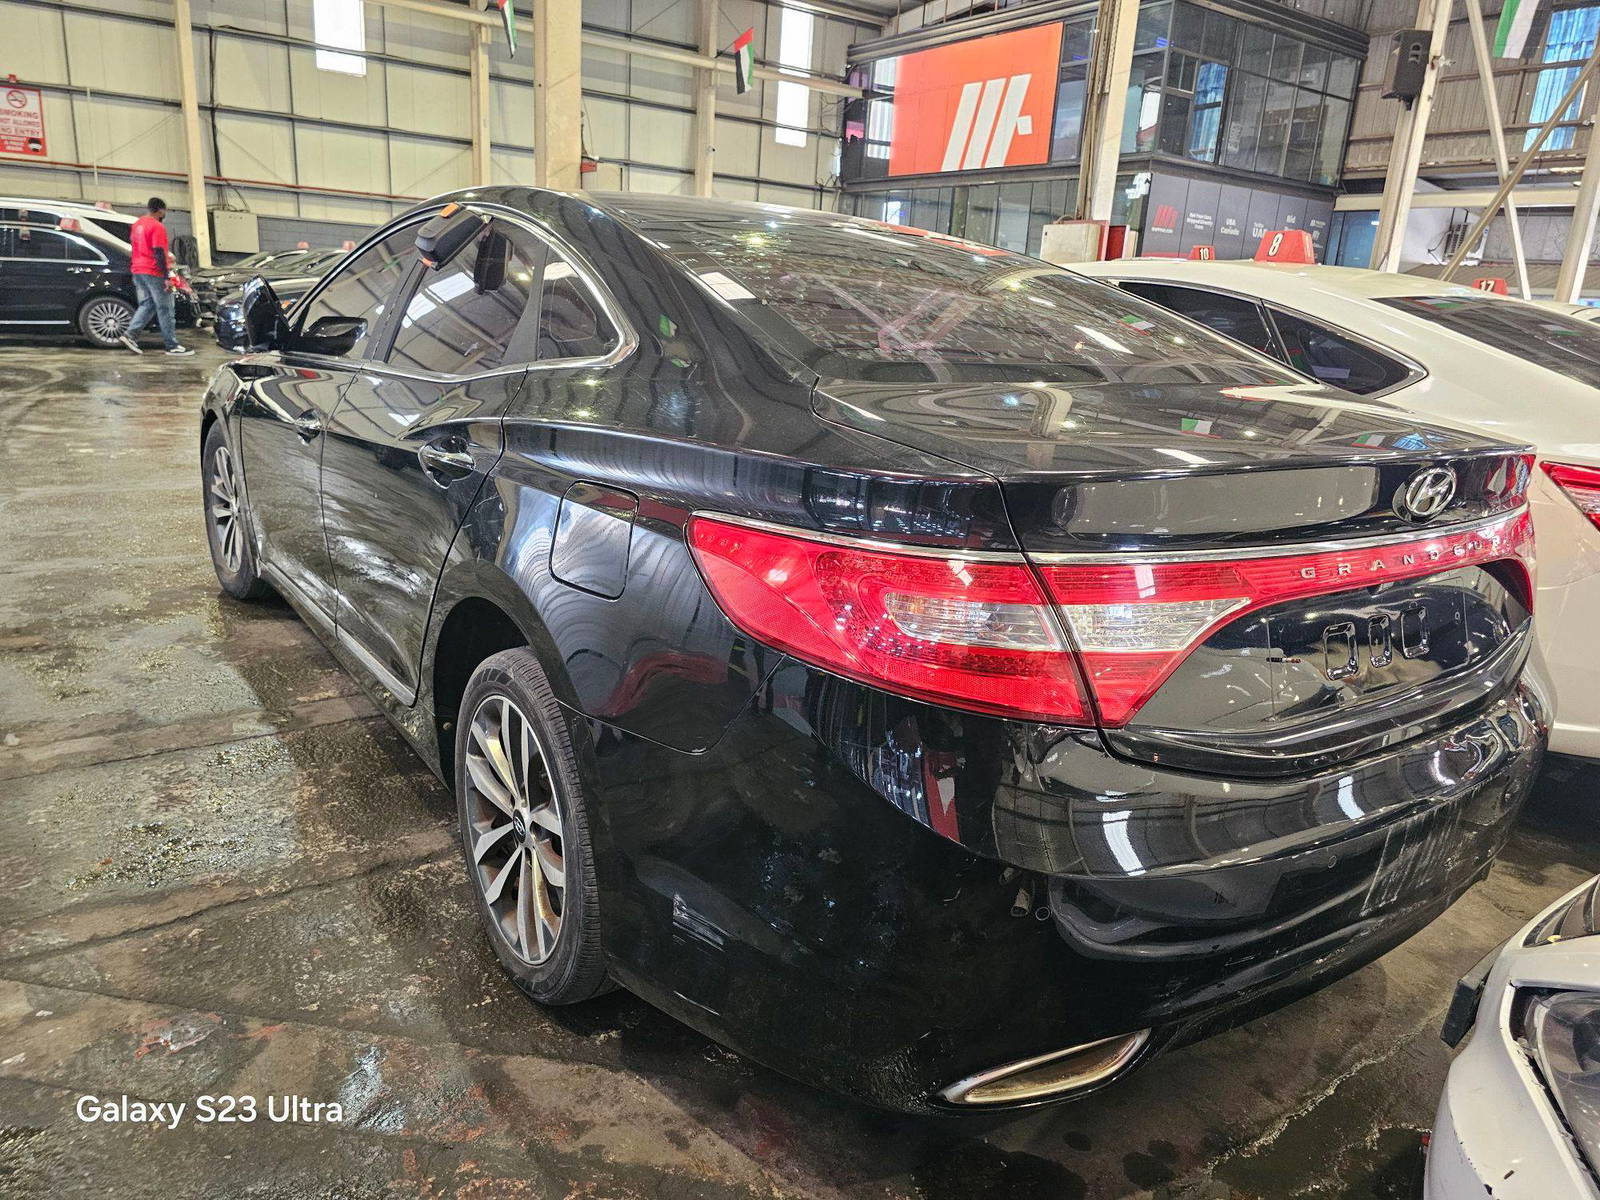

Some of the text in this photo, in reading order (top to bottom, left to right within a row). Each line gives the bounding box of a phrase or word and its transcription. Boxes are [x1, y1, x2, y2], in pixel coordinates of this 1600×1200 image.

[1268, 232, 1283, 256] 8
[1199, 247, 1210, 260] 10
[1480, 280, 1495, 292] 17
